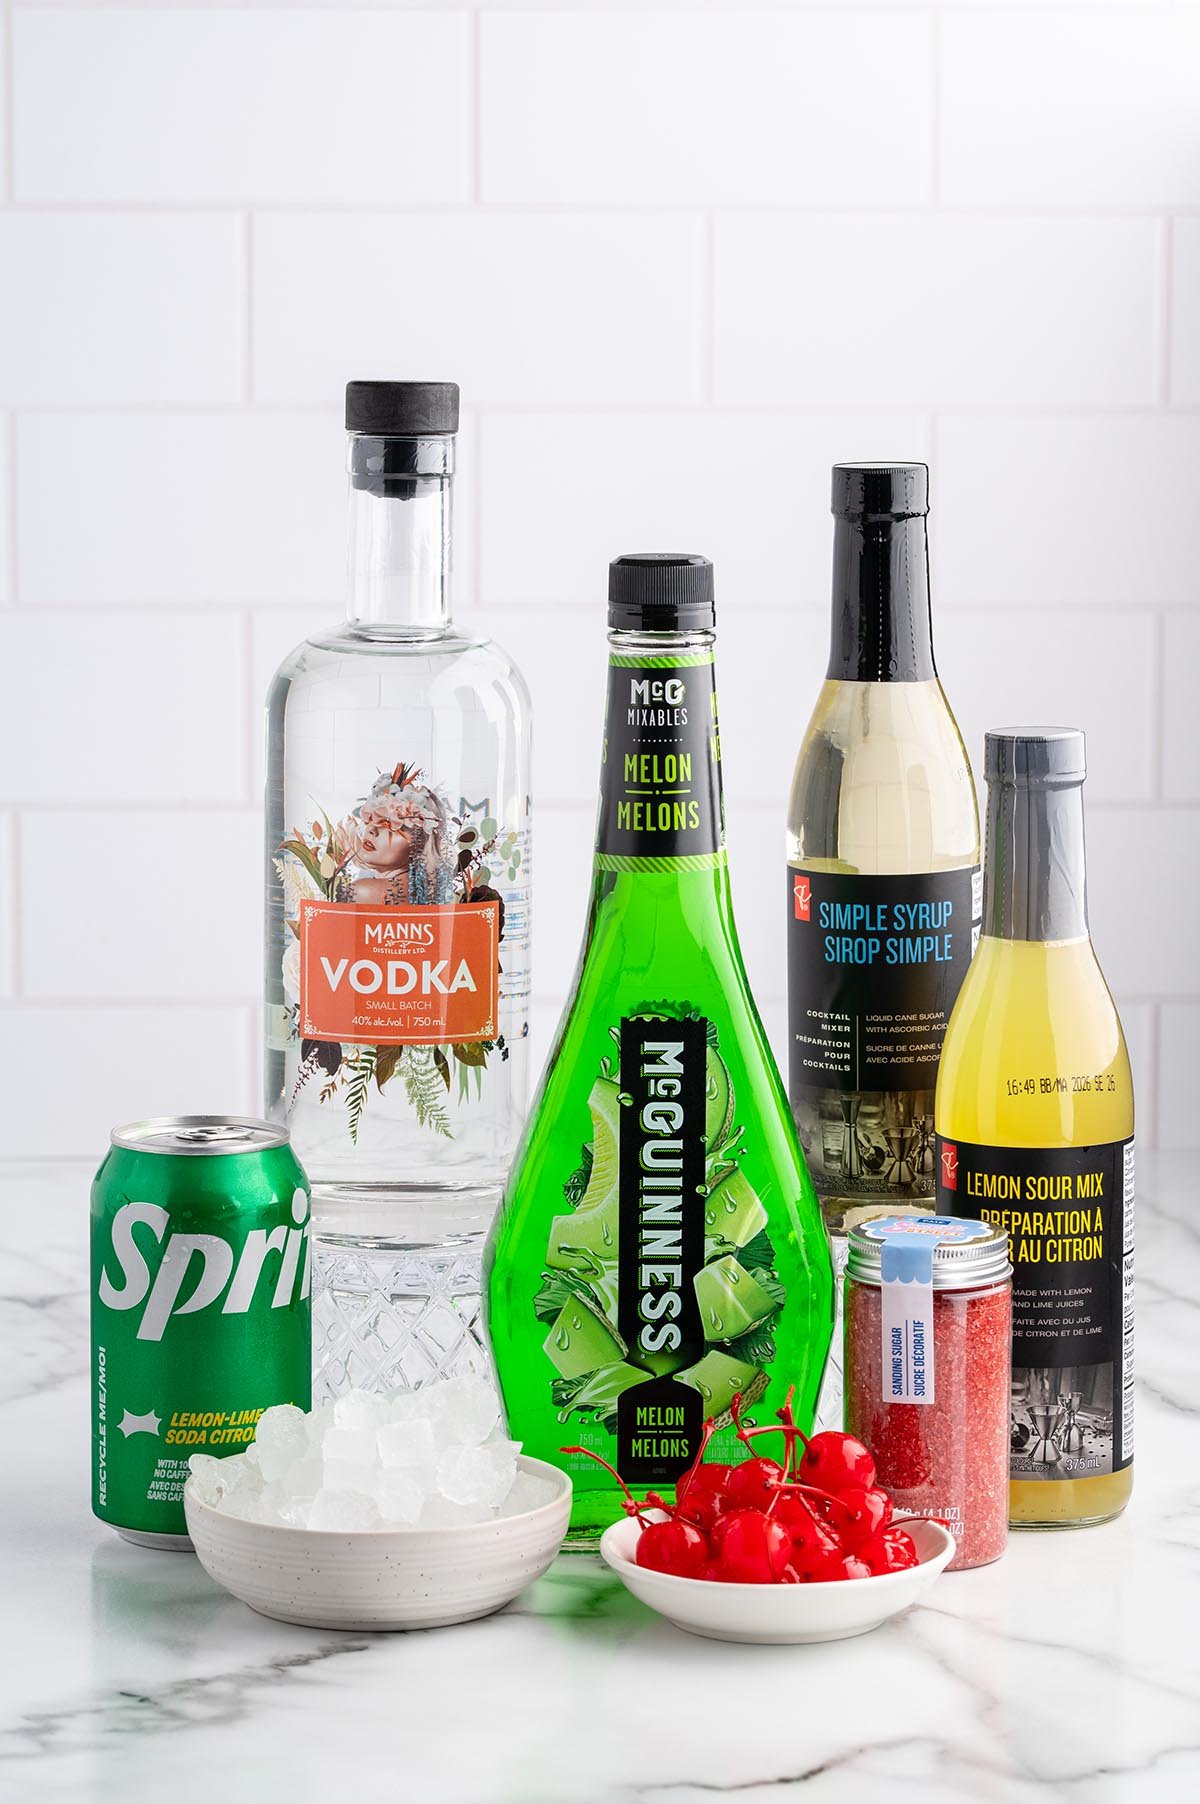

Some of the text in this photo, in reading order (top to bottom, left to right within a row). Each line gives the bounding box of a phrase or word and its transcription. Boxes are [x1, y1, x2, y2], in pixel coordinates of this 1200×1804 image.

[627, 708, 688, 727] MIXABLES
[624, 753, 691, 783] MELON
[617, 800, 700, 831] MELONS
[819, 901, 953, 931] SIMPLE SYRUP
[365, 923, 434, 946] MANNS
[373, 947, 411, 955] DISTILLERY
[824, 935, 880, 964] SIROP
[886, 933, 953, 964] SIMPLE
[320, 957, 477, 995] VODKA
[366, 1001, 431, 1010] SMALL BATCH
[352, 1016, 446, 1027] 40% alc./vol. 750 mL
[806, 1009, 851, 1021] COCKTAIL
[865, 1011, 945, 1022] LIQUID CANE SUGAR
[821, 1023, 851, 1032] MIXER
[889, 1024, 930, 1033] ASCORBIC
[931, 1022, 949, 1031] ACID
[795, 1034, 851, 1048] PRÉPARATION
[909, 1043, 936, 1051] CANNE
[824, 1051, 851, 1060] POUR
[889, 1056, 915, 1064] ACIDE
[802, 1059, 851, 1072] COCKTAILS
[1007, 1075, 1115, 1096] 16:49 BB/MA 2026 SE 26
[967, 1171, 1104, 1201] LEMON SOUR MIX
[639, 1040, 685, 1353] McGUINNESS
[1094, 1206, 1103, 1232] À
[1018, 1239, 1041, 1263] AU
[1046, 1235, 1103, 1263] CITRON
[1011, 1289, 1037, 1297] MADE
[1064, 1287, 1092, 1296] LEMON
[1055, 1300, 1084, 1308] JUICES
[1076, 1316, 1091, 1324] JUS
[1085, 1326, 1103, 1335] LIME
[892, 1327, 903, 1396] SANDING SUGAR
[912, 1320, 925, 1396] SUCRE DÉCORATIF
[636, 1405, 685, 1428] MELON
[98, 1346, 107, 1506] RECYCLE ME/MOI
[165, 1430, 206, 1444] SODA
[580, 1433, 593, 1445] 750
[632, 1438, 690, 1459] MELONS
[157, 1459, 178, 1468] WITH
[1066, 1456, 1100, 1471] 375 mL
[154, 1469, 166, 1478] NO
[149, 1481, 170, 1491] AVEC
[147, 1490, 167, 1500] SANS
